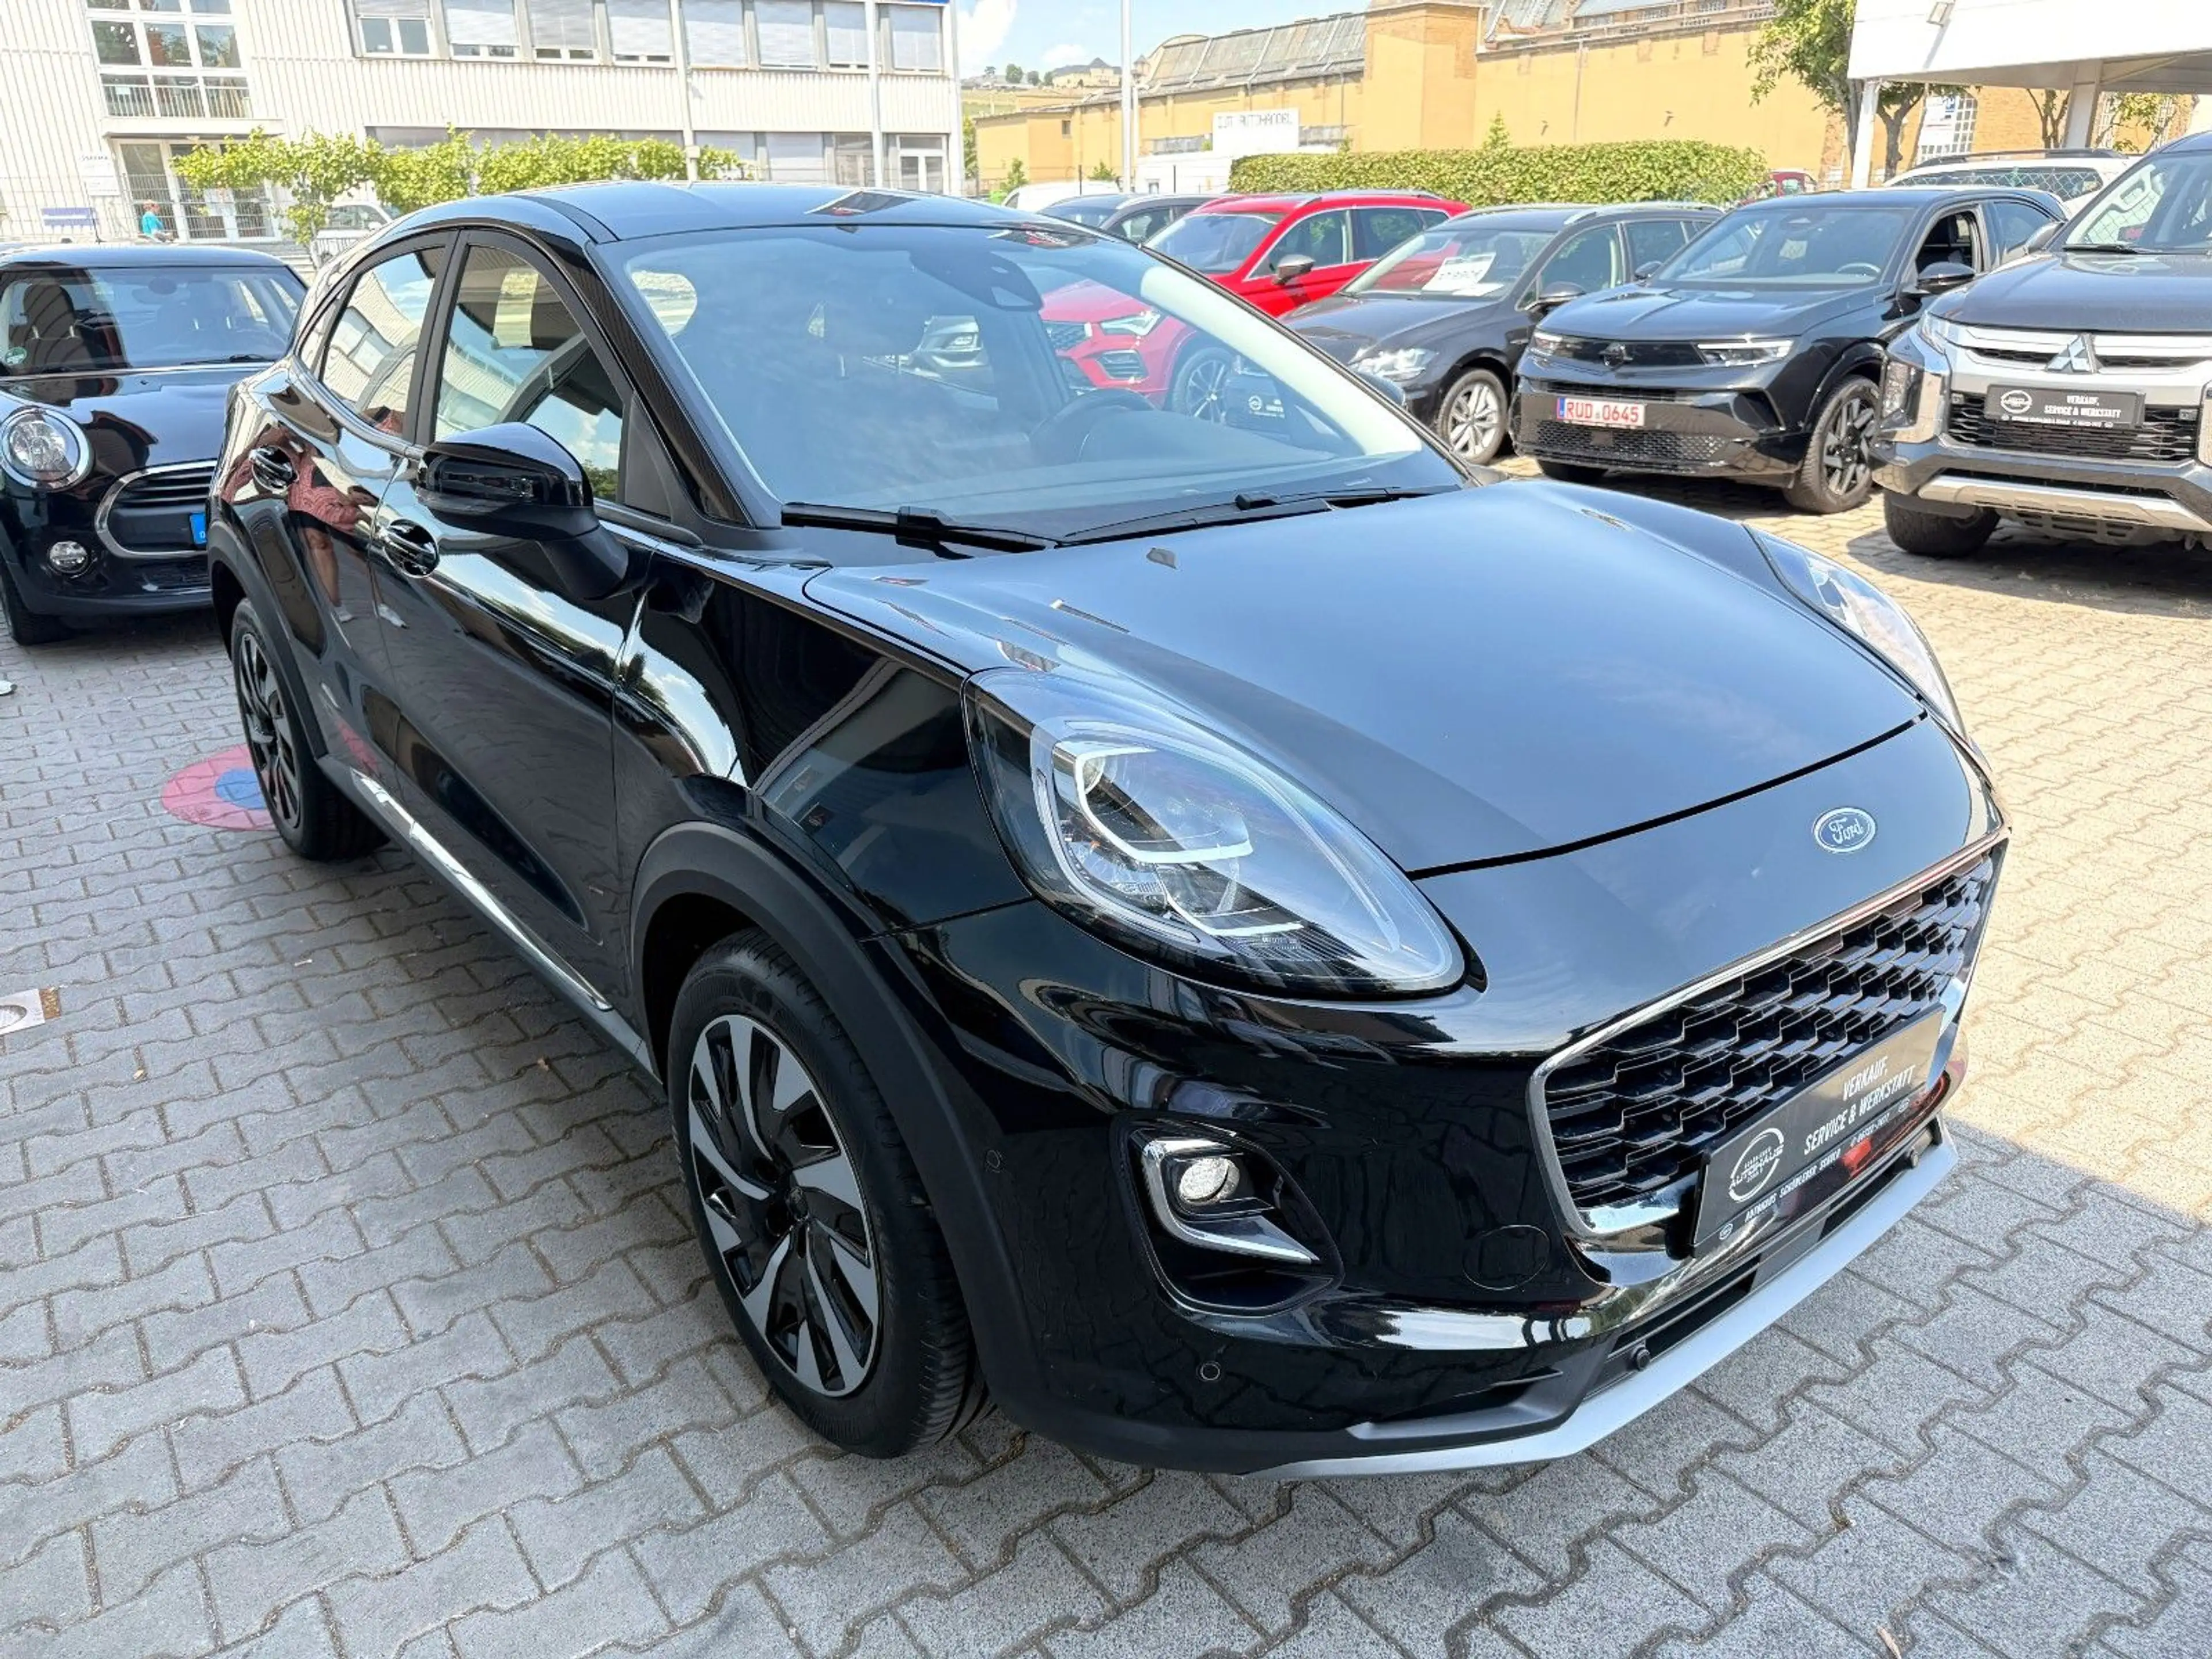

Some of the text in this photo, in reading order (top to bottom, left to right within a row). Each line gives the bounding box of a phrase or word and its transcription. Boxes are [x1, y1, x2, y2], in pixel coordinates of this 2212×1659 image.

[1567, 402, 1639, 423] RUD 0645
[1804, 1110, 1847, 1156] SERVICE
[1847, 1104, 1856, 1124] &
[1858, 1065, 1916, 1119] WERKSTATT
